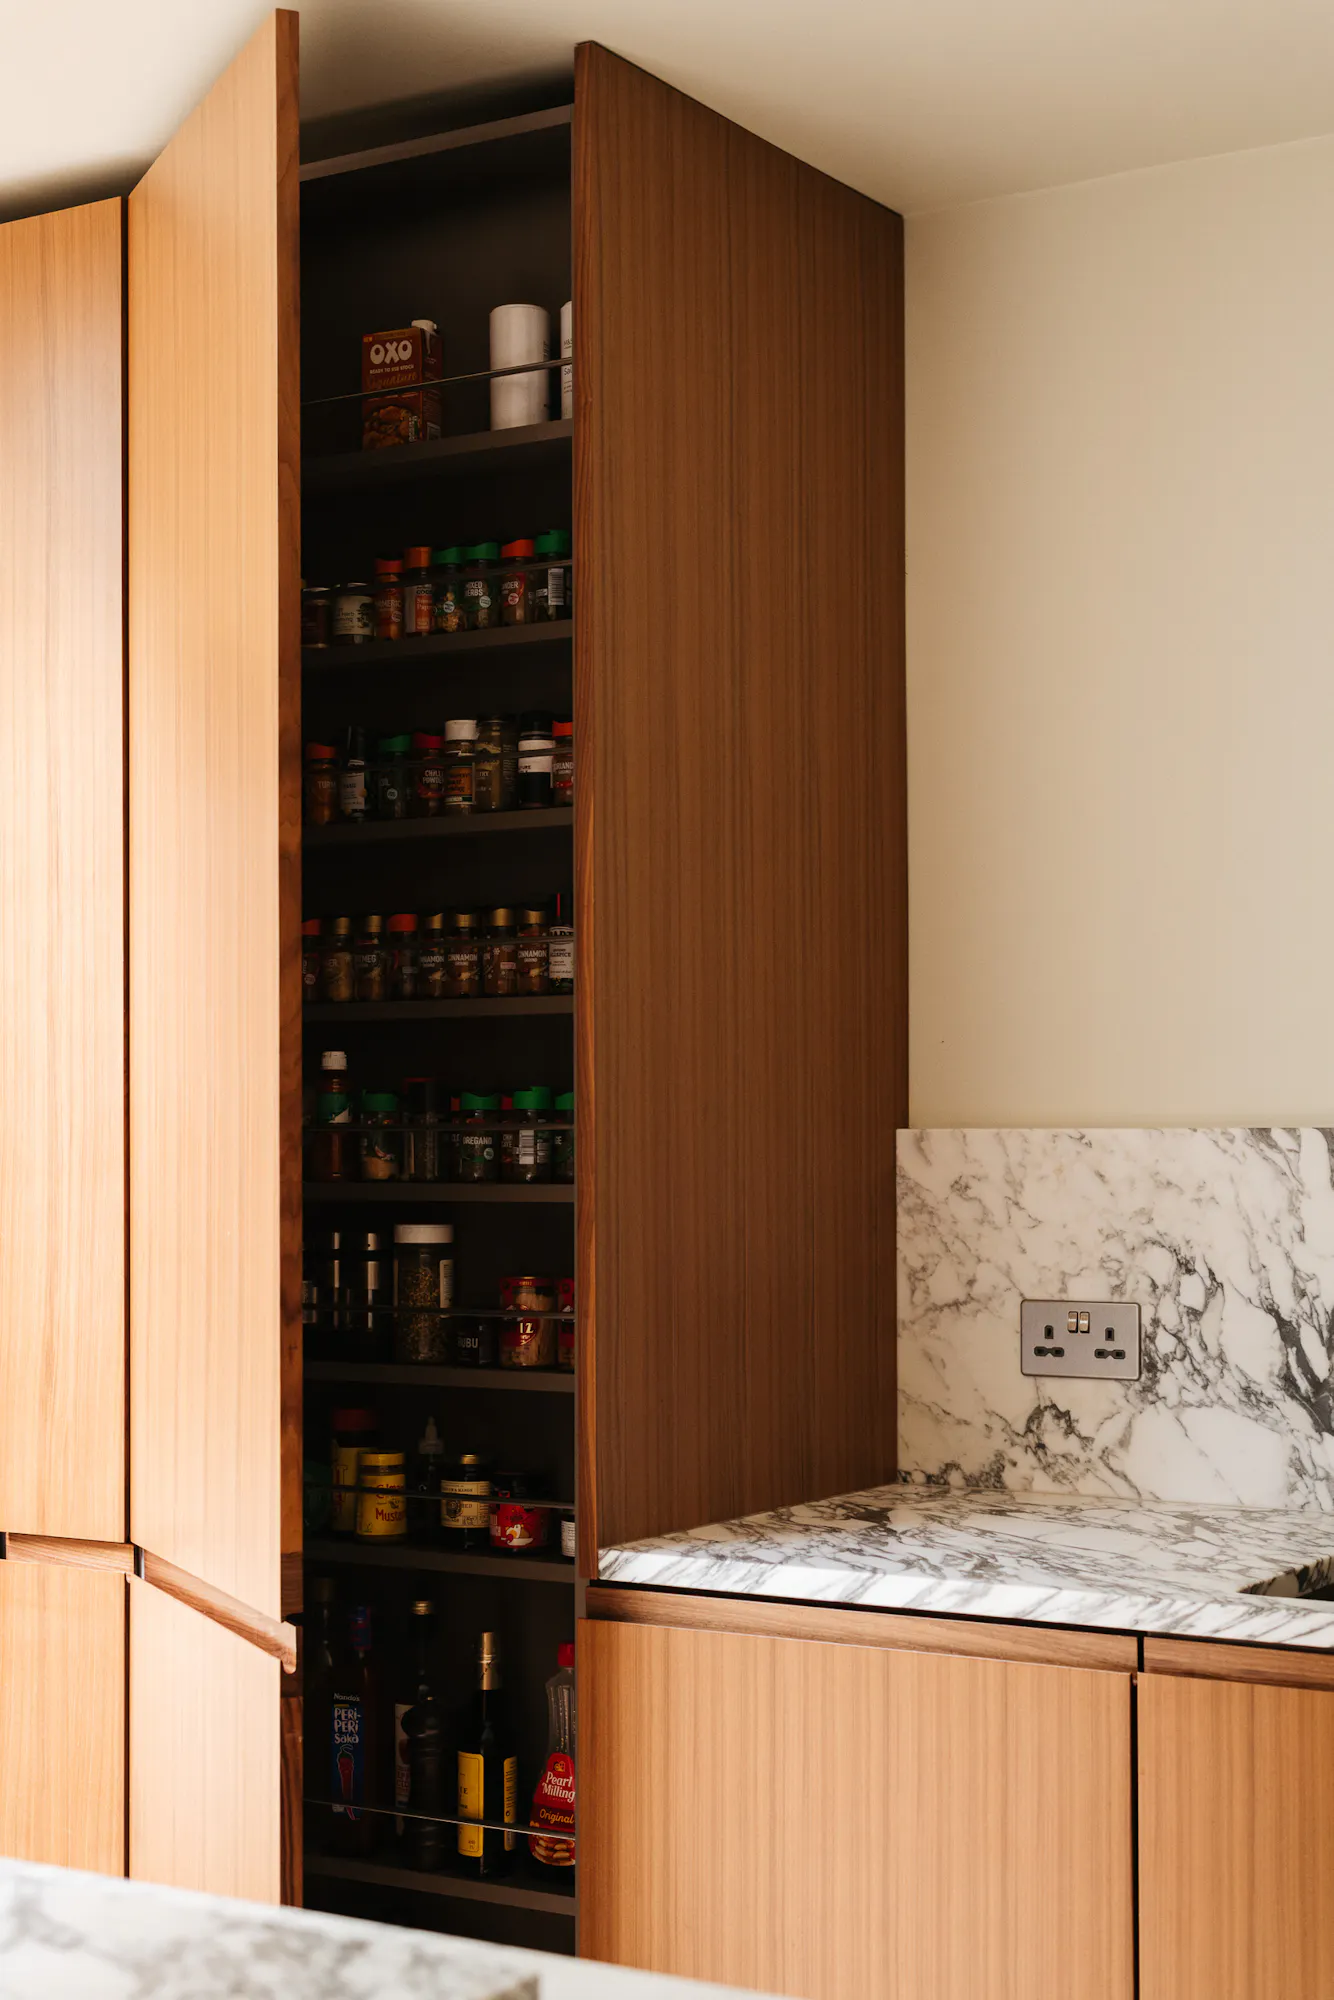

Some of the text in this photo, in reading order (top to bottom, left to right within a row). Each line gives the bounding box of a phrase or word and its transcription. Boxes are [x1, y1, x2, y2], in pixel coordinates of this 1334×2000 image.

[370, 340, 412, 365] OXO
[447, 954, 477, 962] CINNAMON
[517, 949, 547, 959] CINNAMON
[462, 1136, 493, 1145] OREGANO
[333, 1692, 360, 1702] Nando's
[334, 1733, 359, 1744] Saka
[546, 1771, 573, 1788] Pearl
[542, 1782, 576, 1804] Milling
[539, 1808, 575, 1825] Original
